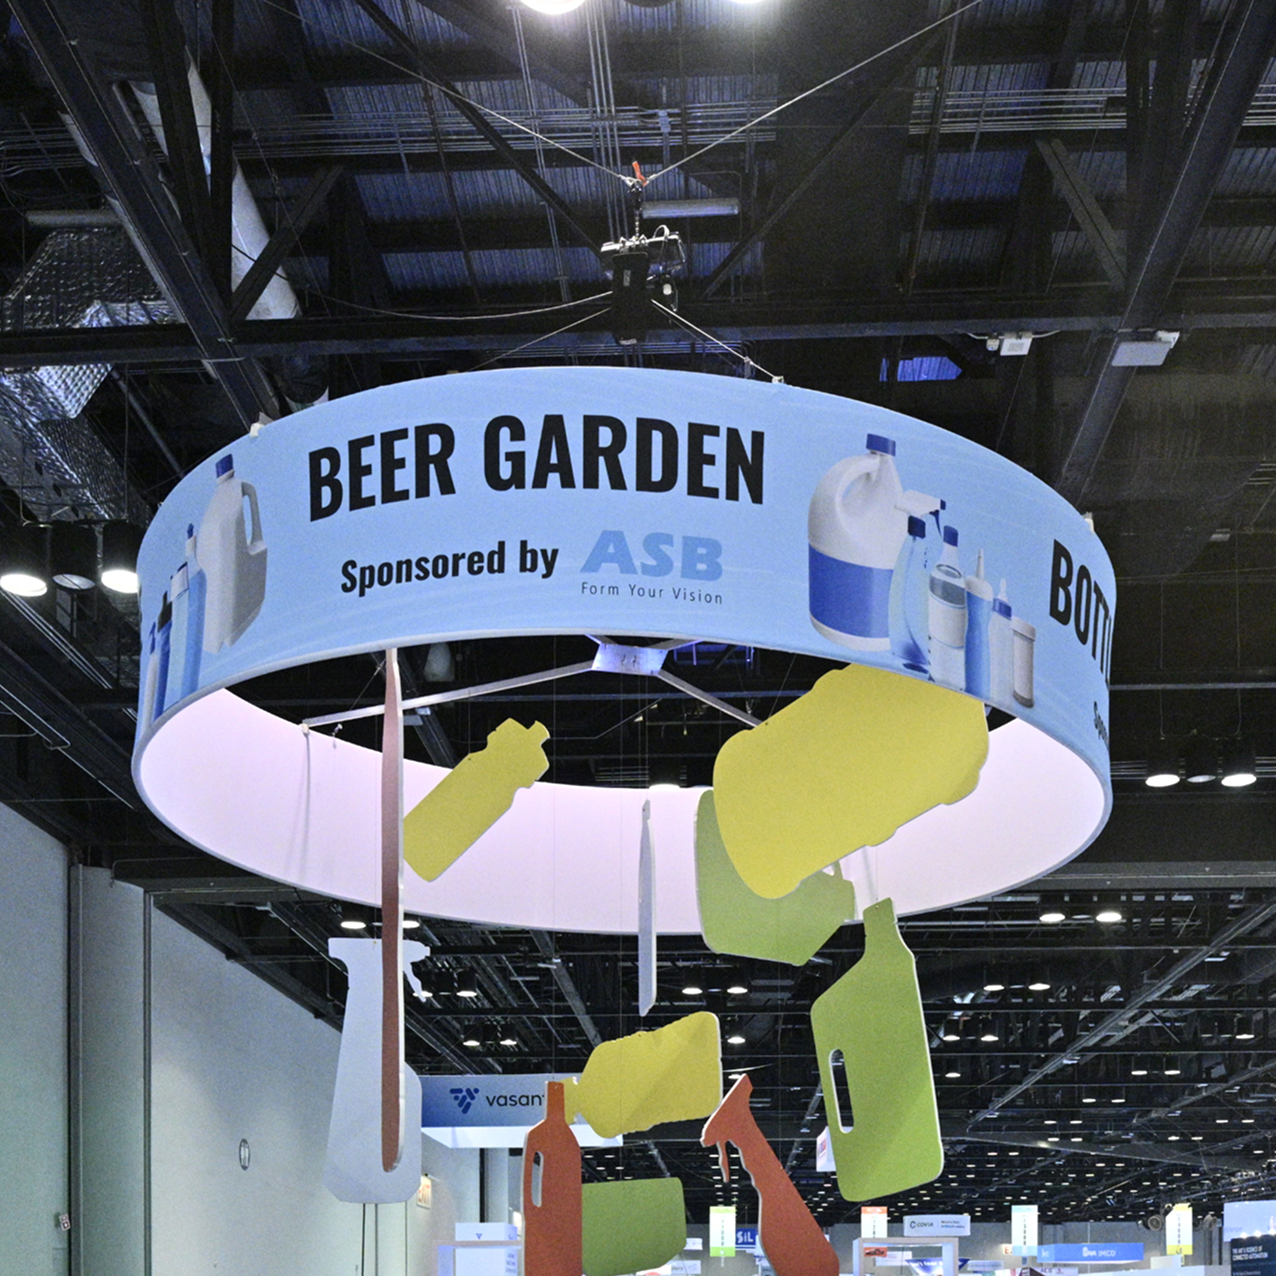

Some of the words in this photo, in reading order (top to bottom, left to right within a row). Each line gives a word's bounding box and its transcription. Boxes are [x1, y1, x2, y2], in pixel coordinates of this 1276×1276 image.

[309, 422, 456, 523] BEER
[483, 414, 765, 505] GARDEN
[341, 540, 505, 598] Sponsored
[518, 539, 559, 579] by
[579, 529, 724, 582] ASB
[581, 581, 620, 596] Form
[628, 583, 664, 598] Your
[672, 587, 723, 605] Vision
[485, 1092, 545, 1107] vasan
